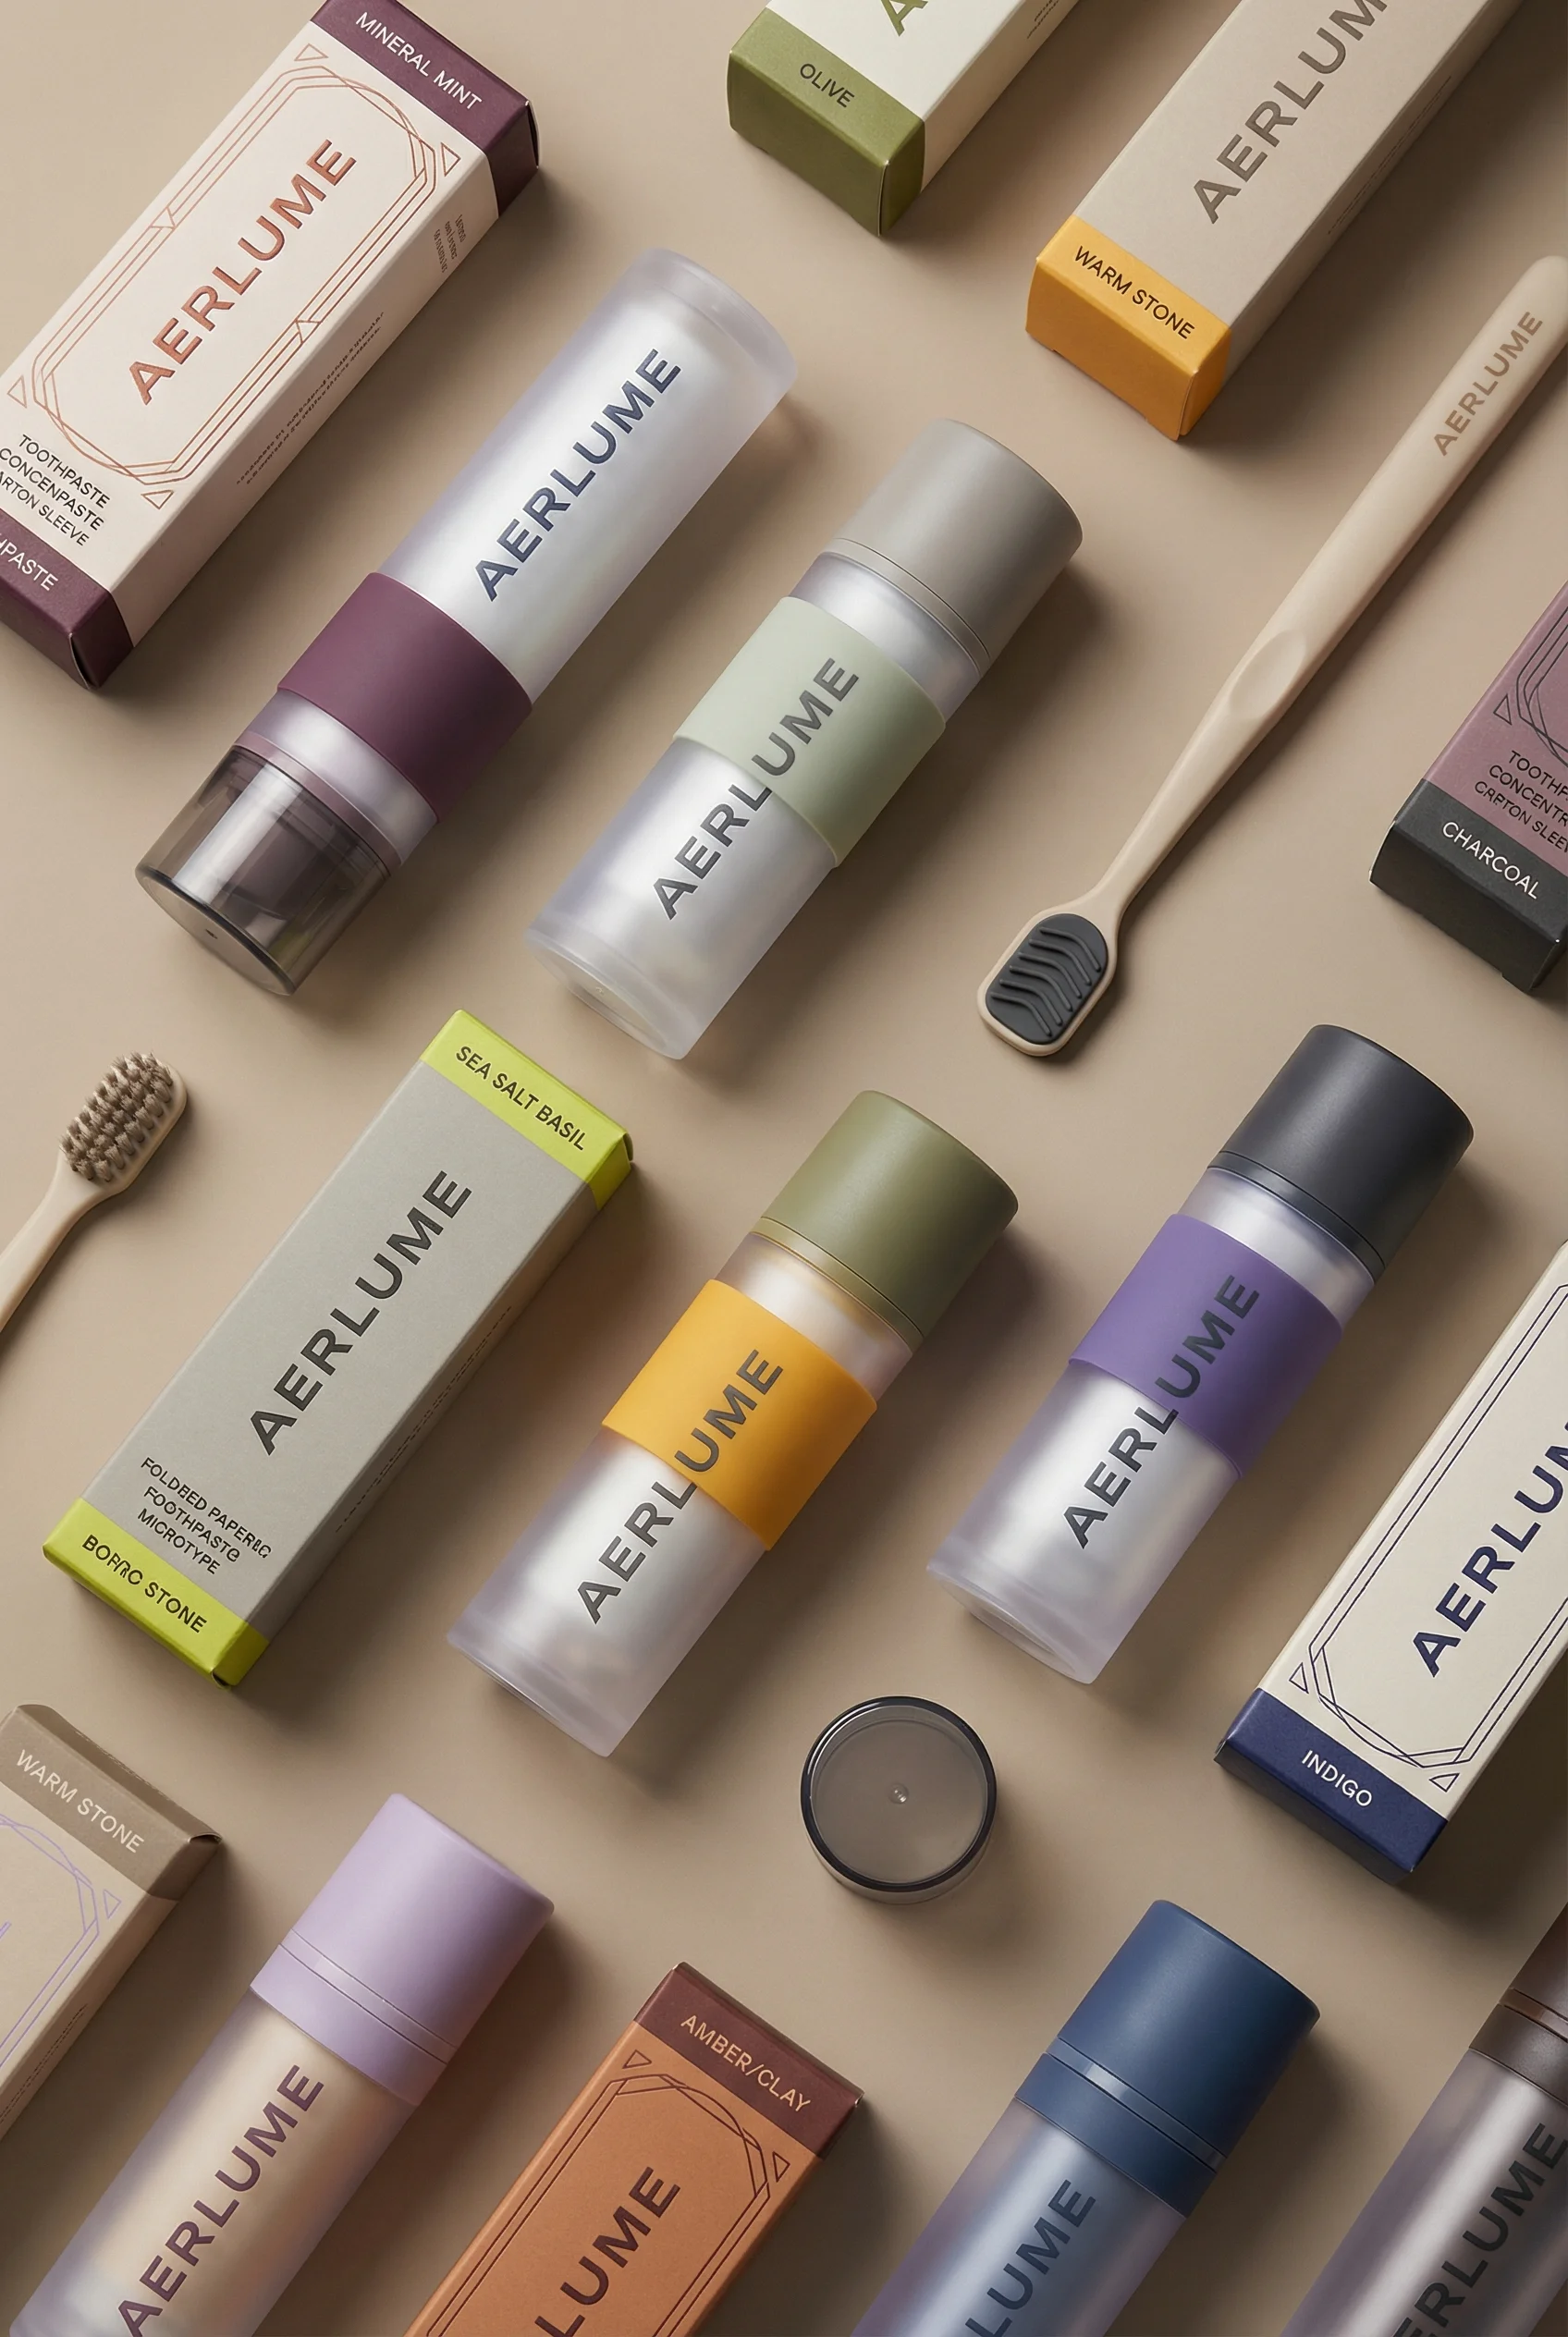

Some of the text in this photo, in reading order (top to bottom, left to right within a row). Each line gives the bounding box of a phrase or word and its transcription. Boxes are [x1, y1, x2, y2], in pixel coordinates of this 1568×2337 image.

[355, 11, 483, 110] MINERAL MINT
[800, 63, 855, 108] OLIVE
[127, 139, 358, 406] AERLUME
[1074, 245, 1195, 339] WARM STONE
[1433, 312, 1544, 457] AERLUME
[0, 447, 104, 531] CONCENPASTE
[18, 434, 111, 508] TOOTHPASTE
[473, 348, 682, 603] AERLUME
[39, 505, 90, 546] SLEEVE
[653, 657, 860, 921] AERLUME
[1442, 821, 1539, 899] CHARCOAL
[456, 1046, 586, 1151] SEA SALT BASIL
[250, 1169, 473, 1456] AERLUME
[1061, 1273, 1261, 1550] AERLUME
[575, 1349, 784, 1625] AERLUME
[137, 1508, 221, 1575] MICROTYPE
[144, 1581, 207, 1633] STONE
[16, 1749, 145, 1854] WARM STONE
[1301, 1749, 1372, 1806] INDIGO
[680, 2014, 812, 2112] AMBER/CLAY
[117, 2064, 325, 2337] AERLUME
